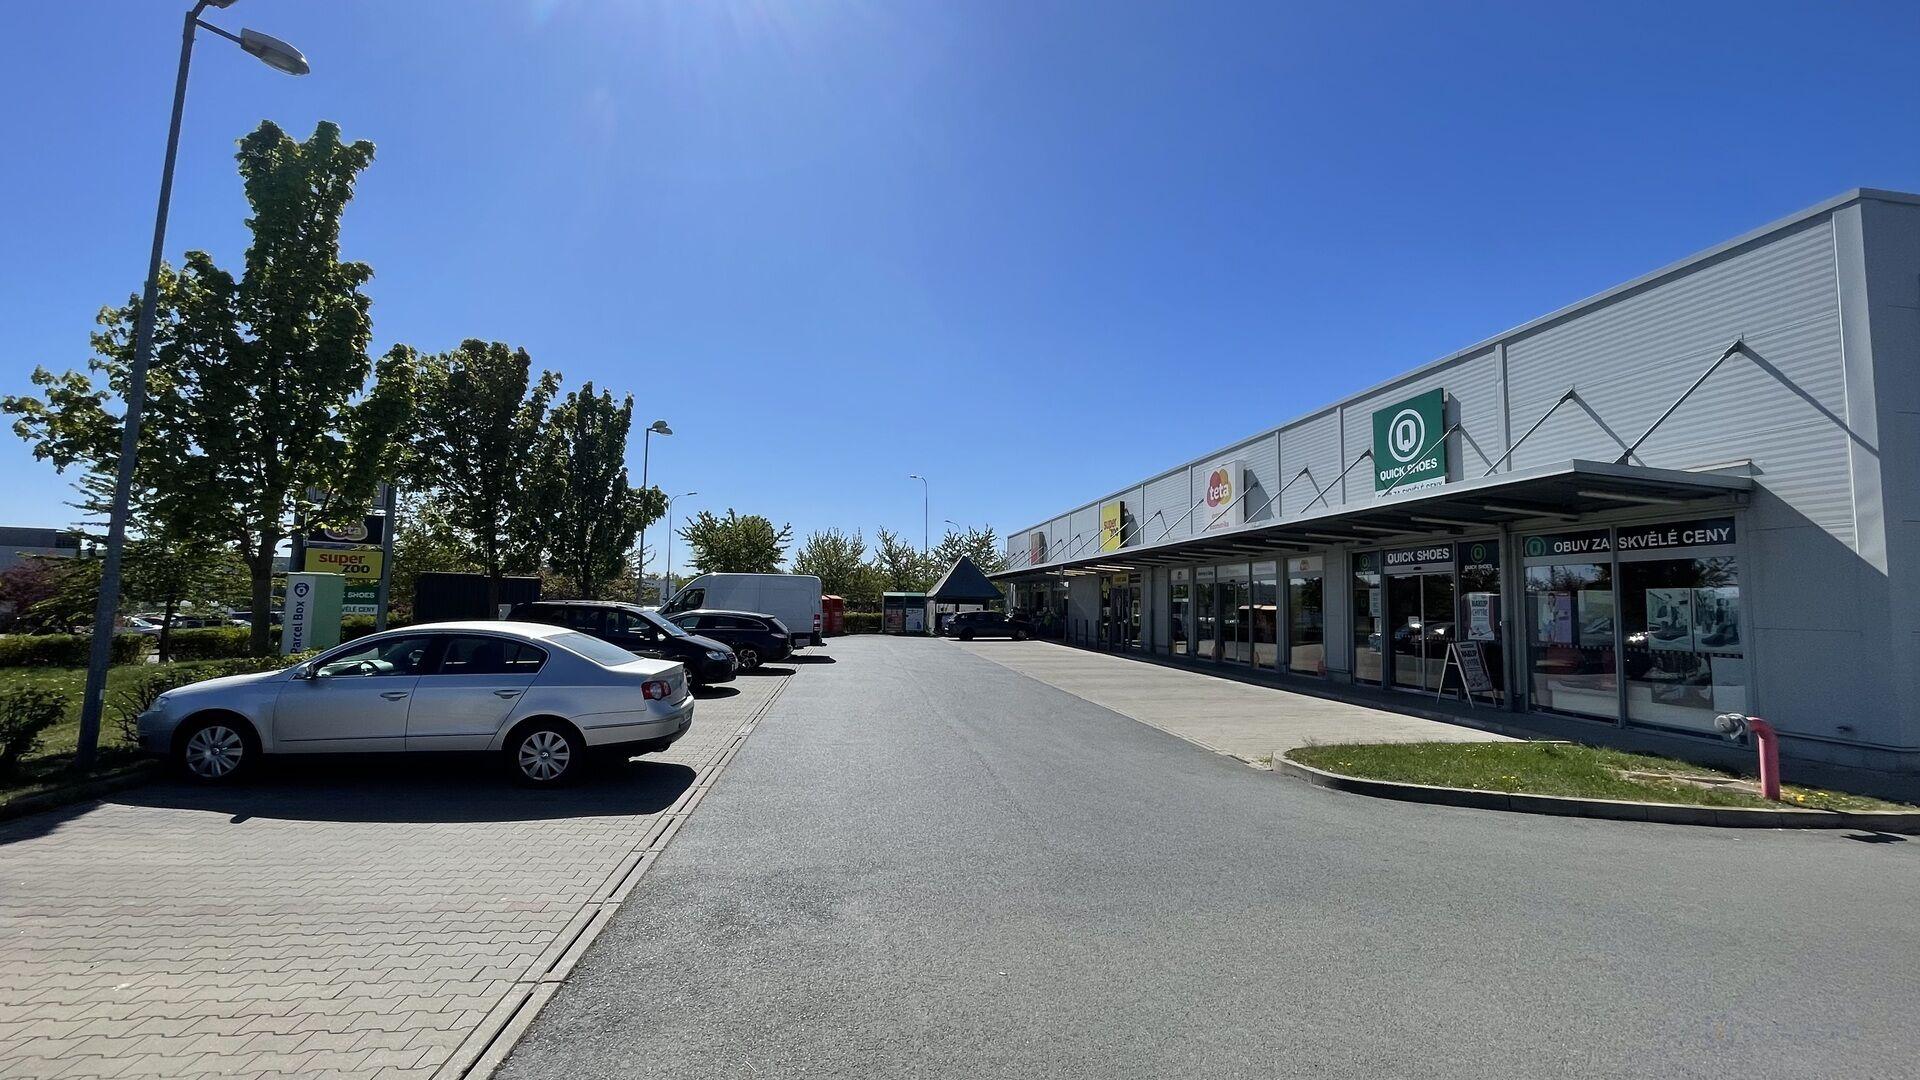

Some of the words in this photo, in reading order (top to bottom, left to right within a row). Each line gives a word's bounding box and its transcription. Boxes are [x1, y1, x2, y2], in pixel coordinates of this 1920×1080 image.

[1380, 466, 1406, 481] QUICK
[1408, 457, 1438, 475] SHOES
[1209, 483, 1230, 501] teta
[1103, 518, 1117, 530] super
[1554, 539, 1589, 553] OBUV
[1592, 538, 1610, 550] ZA
[1618, 529, 1679, 549] SKVĚLÉ
[1682, 527, 1730, 544] CENY
[319, 553, 365, 566] super
[1387, 551, 1415, 564] QUICK
[1416, 548, 1450, 561] SHOES
[347, 591, 375, 599] SHOES
[293, 601, 305, 621] Box
[358, 605, 376, 613] CENY
[290, 623, 303, 654] Parcel
